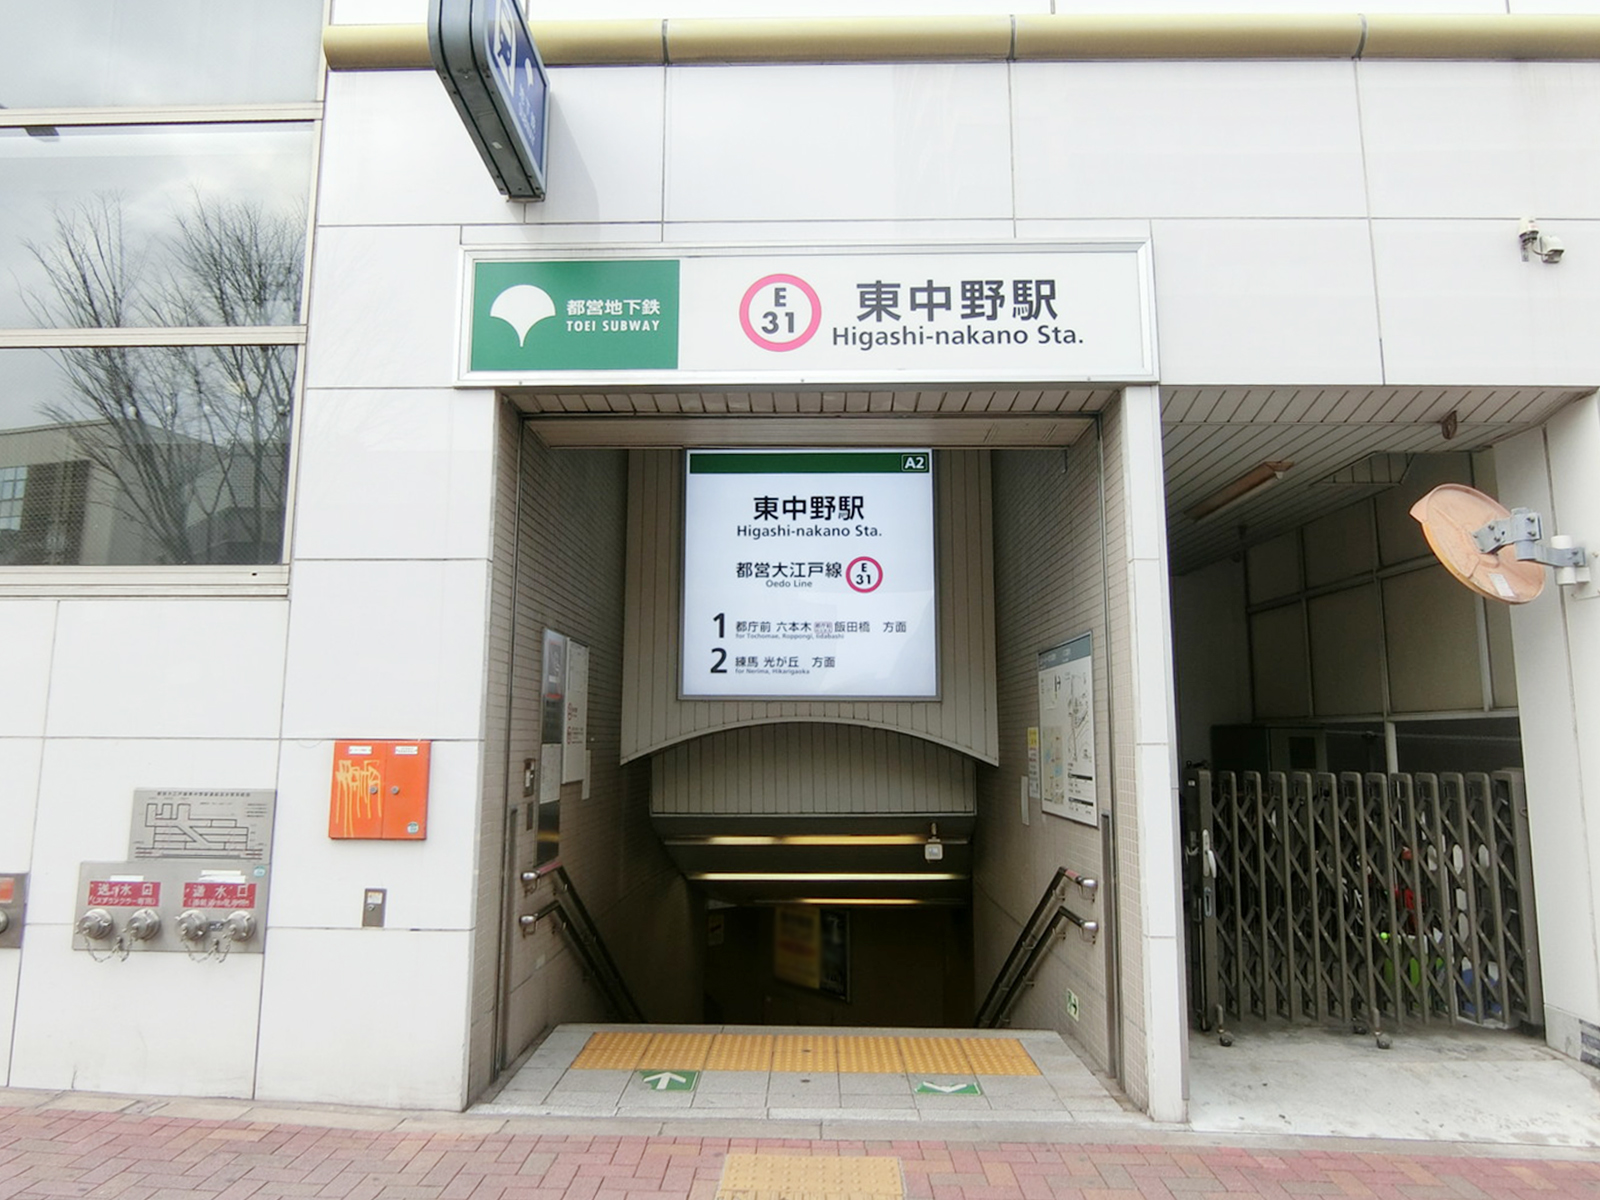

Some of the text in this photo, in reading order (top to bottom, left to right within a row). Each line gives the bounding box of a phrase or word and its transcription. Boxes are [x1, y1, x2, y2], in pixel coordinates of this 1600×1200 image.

[774, 287, 787, 307] E
[856, 279, 1059, 322] 東中野駅
[566, 299, 661, 316] 都営地下鉄
[566, 320, 660, 332] TOEI SUBWAY
[761, 311, 795, 334] 31
[832, 324, 1084, 351] Higashi-nakano Sta.
[904, 456, 925, 469] A2
[753, 496, 865, 521] 東中野駅
[736, 525, 882, 540] Higashi-nakano Sta.
[736, 561, 842, 579] 都営大江戸線
[861, 562, 868, 573] E
[766, 579, 813, 588] Oedo Line
[855, 574, 872, 586] 31
[713, 612, 725, 638] 1
[736, 621, 771, 632] 都庁前
[776, 621, 812, 632] 六本木
[834, 621, 870, 633] 飯田橋
[883, 621, 907, 632] 方面
[710, 647, 728, 674] 2
[735, 656, 836, 668] 練馬 光が丘 方面
